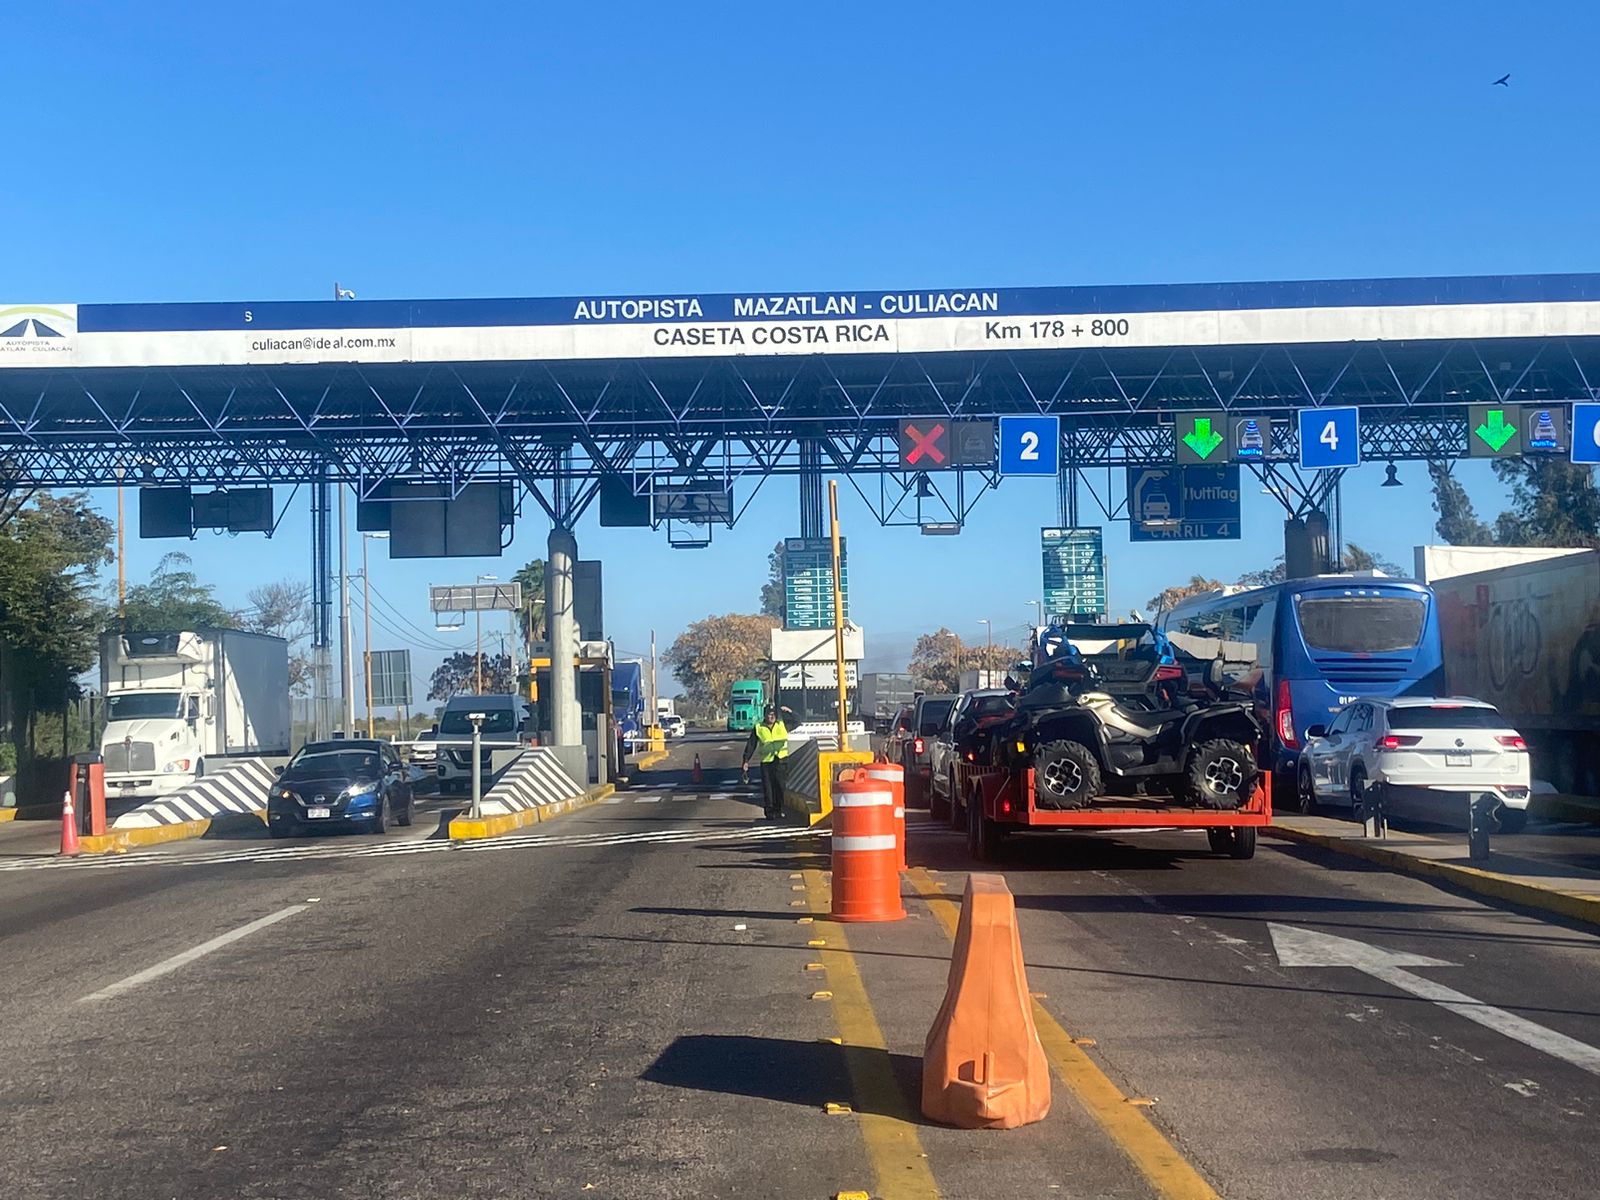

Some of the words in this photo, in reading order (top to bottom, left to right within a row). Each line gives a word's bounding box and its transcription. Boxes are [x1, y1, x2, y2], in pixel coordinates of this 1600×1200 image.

[574, 299, 703, 320] AUTOPISTA
[734, 296, 856, 316] MAZATLAN
[880, 293, 999, 314] CULIACAN
[653, 327, 745, 346] CASETA
[752, 325, 829, 345] COSTA
[836, 323, 890, 344] RICA
[985, 321, 1022, 340] Km
[1029, 319, 1065, 339] 178
[1091, 318, 1129, 337] 800
[1020, 431, 1039, 459] 2
[1320, 421, 1339, 451] 4
[1217, 523, 1230, 537] 4
